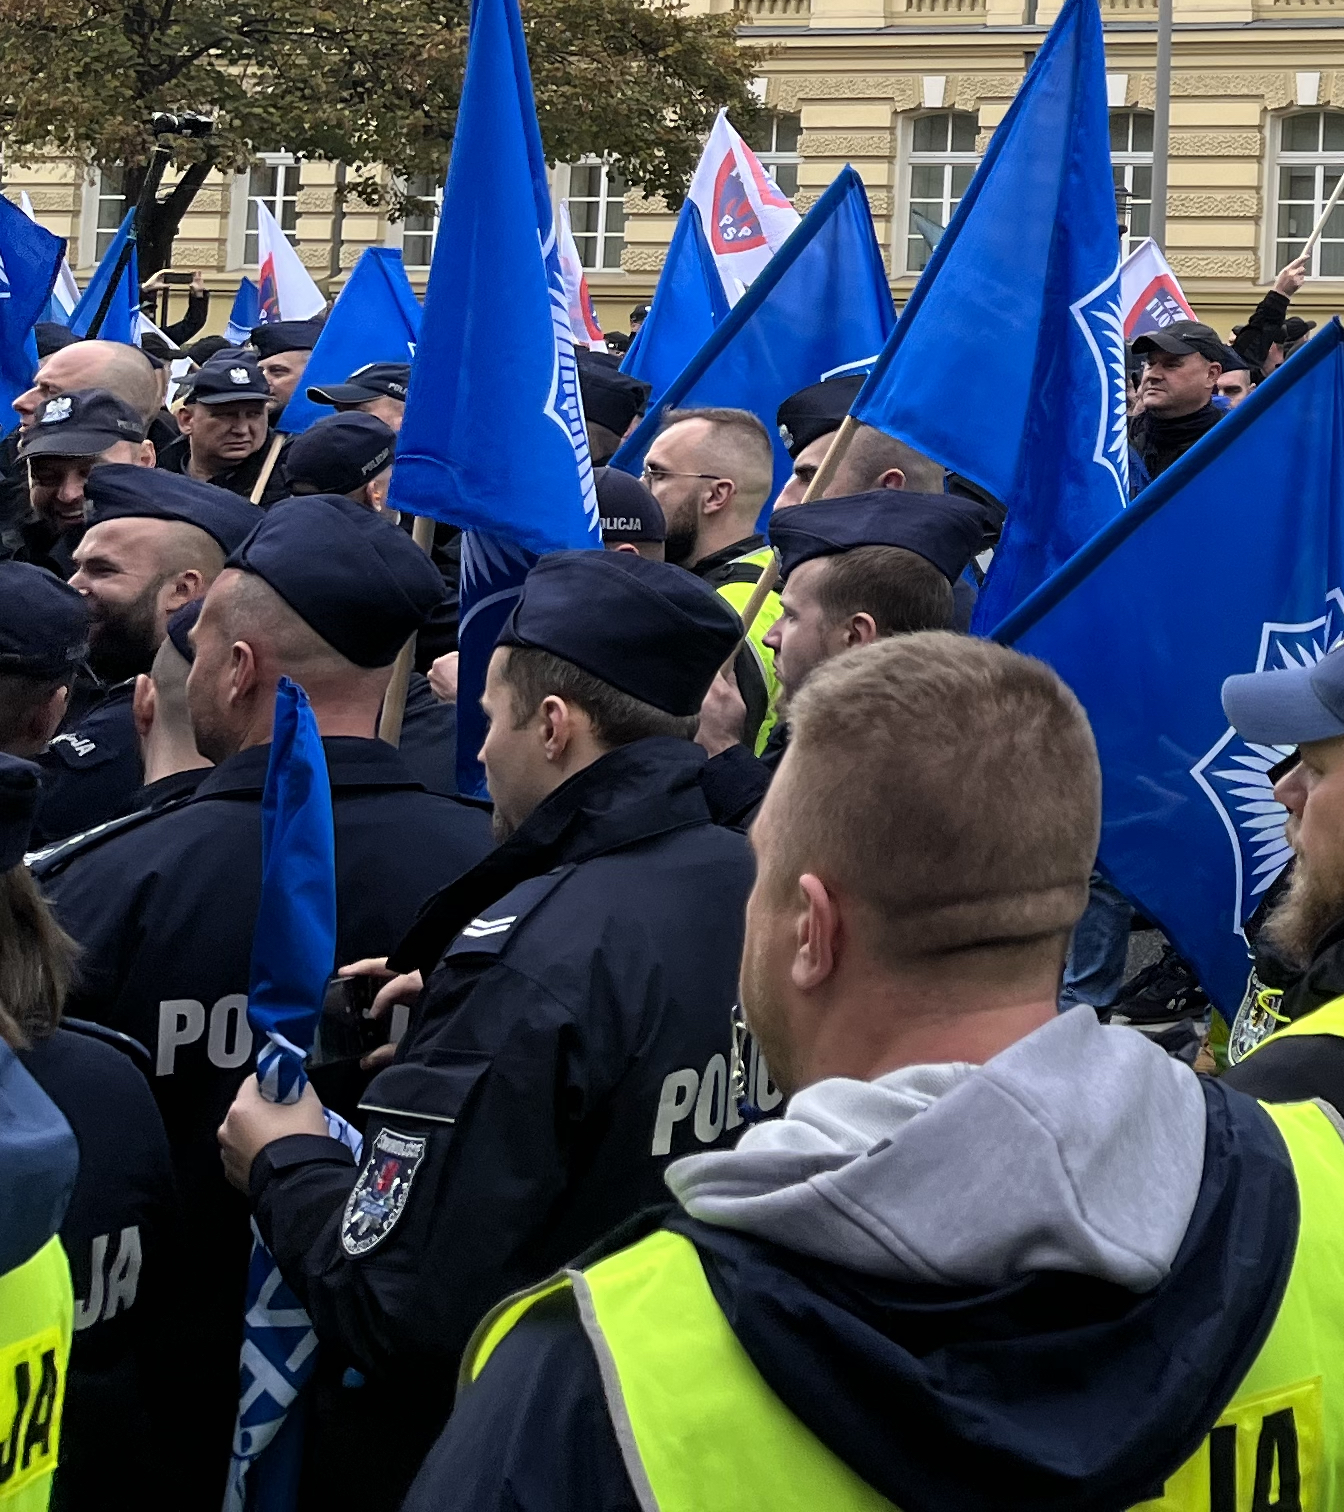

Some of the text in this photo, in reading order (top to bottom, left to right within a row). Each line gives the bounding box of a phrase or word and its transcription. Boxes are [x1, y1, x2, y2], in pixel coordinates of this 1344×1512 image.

[719, 214, 753, 240] PSP
[600, 517, 642, 531] OLICJA
[651, 1038, 783, 1156] POLIC
